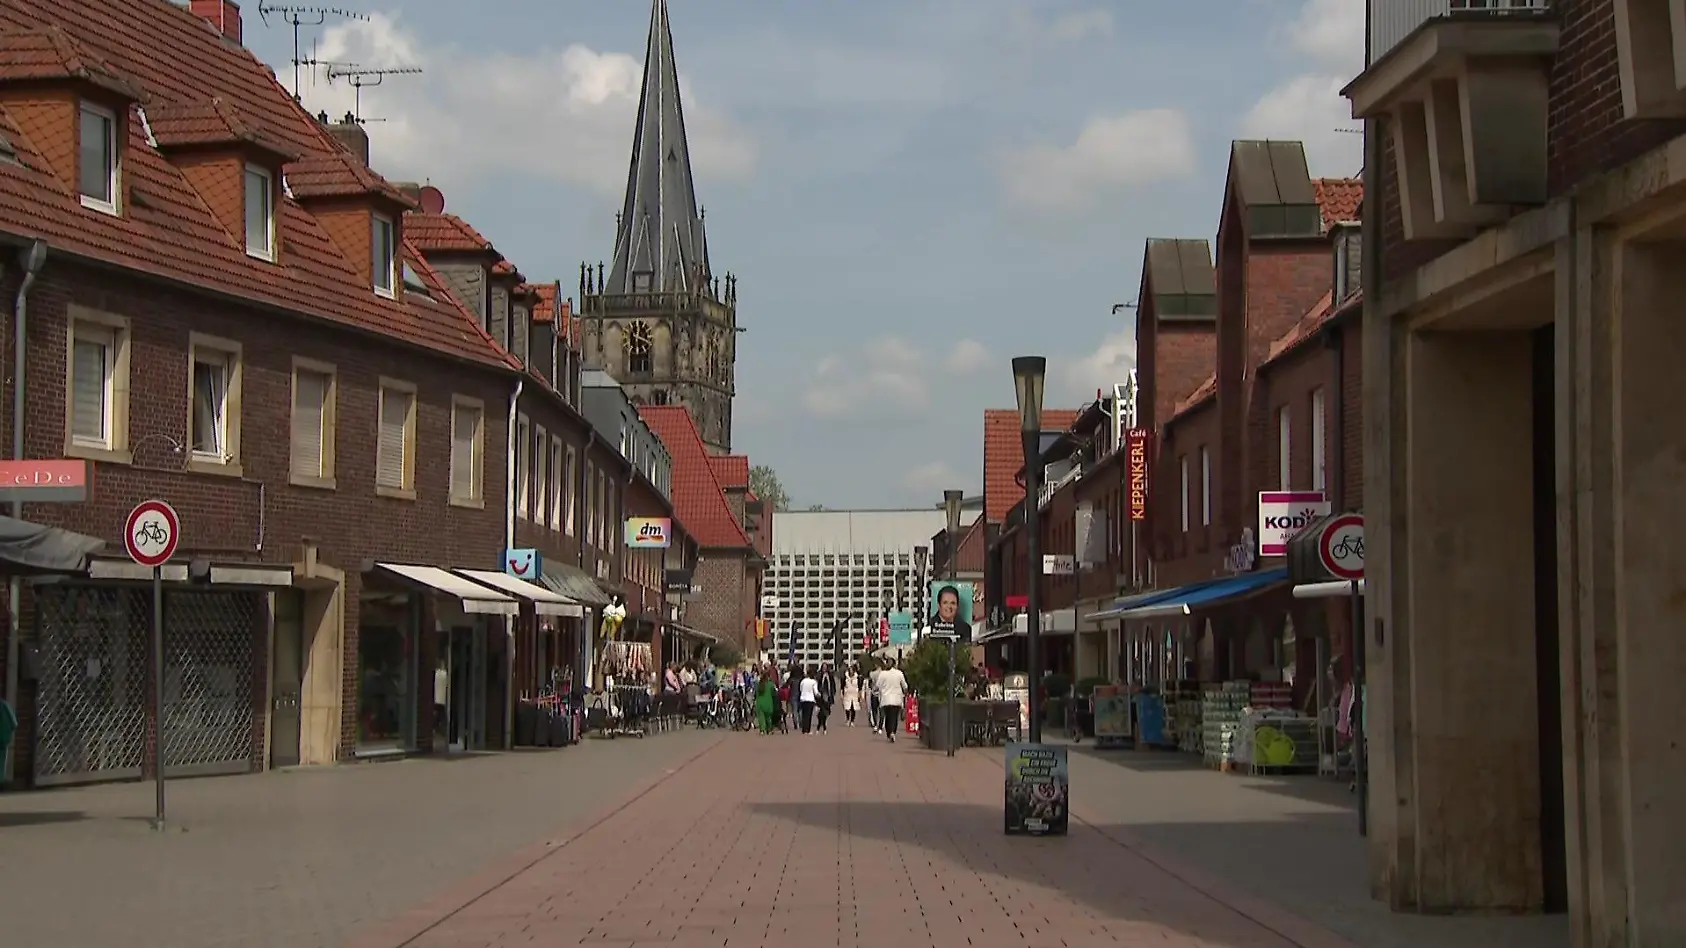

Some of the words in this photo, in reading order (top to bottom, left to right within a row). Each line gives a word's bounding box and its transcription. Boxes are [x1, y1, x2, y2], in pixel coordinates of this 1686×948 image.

[1129, 429, 1146, 437] Café
[1131, 439, 1144, 519] KIEPENKERL
[640, 522, 662, 535] dm
